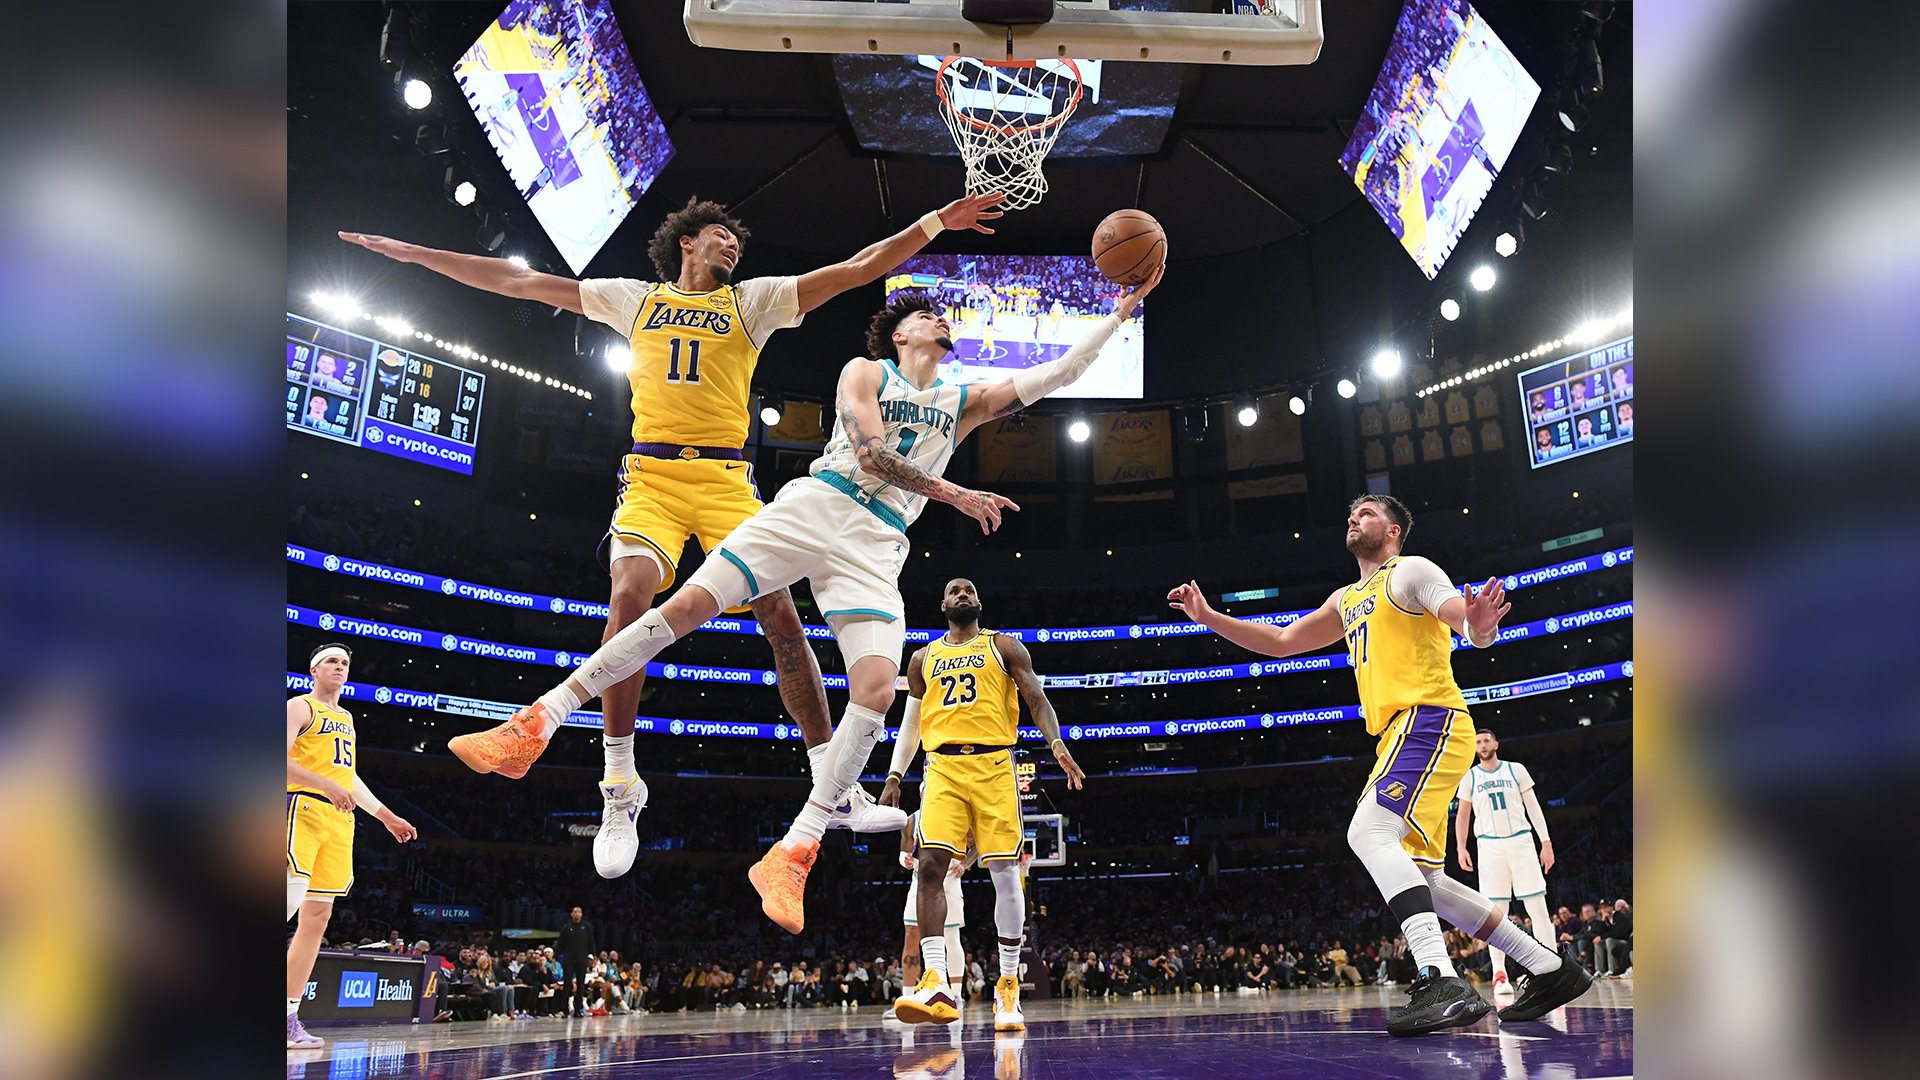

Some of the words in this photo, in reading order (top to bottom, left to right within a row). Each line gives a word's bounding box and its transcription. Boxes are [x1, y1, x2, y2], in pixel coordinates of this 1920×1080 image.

[1238, 5, 1254, 15] NBA
[642, 302, 732, 335] LAKERS
[294, 345, 310, 361] 10
[1607, 344, 1626, 364] THE
[345, 361, 357, 376] 2
[407, 359, 421, 375] 28
[667, 338, 701, 385] 11
[404, 378, 417, 394] 21
[464, 376, 479, 392] 46
[1593, 373, 1602, 386] 2
[338, 400, 350, 416] 0
[462, 395, 476, 411] 37
[413, 402, 441, 426] 1:03
[879, 400, 954, 439] CHARLOTTE
[1557, 421, 1570, 436] 12
[386, 434, 472, 465] crypto.com
[896, 427, 918, 457] 1
[343, 560, 424, 587] crypto.com
[1519, 560, 1587, 585] crypto.com
[459, 584, 533, 607] crypto.com
[1235, 589, 1265, 597] AMERICAN
[1345, 594, 1376, 633] LAKERS
[1561, 604, 1633, 628] crypto.com
[339, 618, 422, 643] crypto.com
[1052, 628, 1115, 641] crypto.com
[1144, 624, 1207, 637] crypto.com
[460, 642, 536, 661] crypto.com
[1348, 621, 1369, 671] 77
[930, 654, 986, 680] LAKERS
[1264, 658, 1330, 674] crypto.com
[680, 668, 751, 682] crypto.com
[1093, 675, 1108, 686] 37
[1170, 667, 1233, 682] crypto.com
[940, 673, 978, 707] 23
[1276, 709, 1343, 726] crypto.com
[687, 723, 758, 737] crypto.com
[1085, 724, 1150, 738] crypto.com
[1181, 718, 1246, 734] crypto.com
[332, 737, 352, 768] 15
[1477, 780, 1512, 793] CHARLOTTE
[1489, 791, 1506, 811] 11
[344, 980, 371, 999] UCLA
[377, 979, 413, 1000] Health
